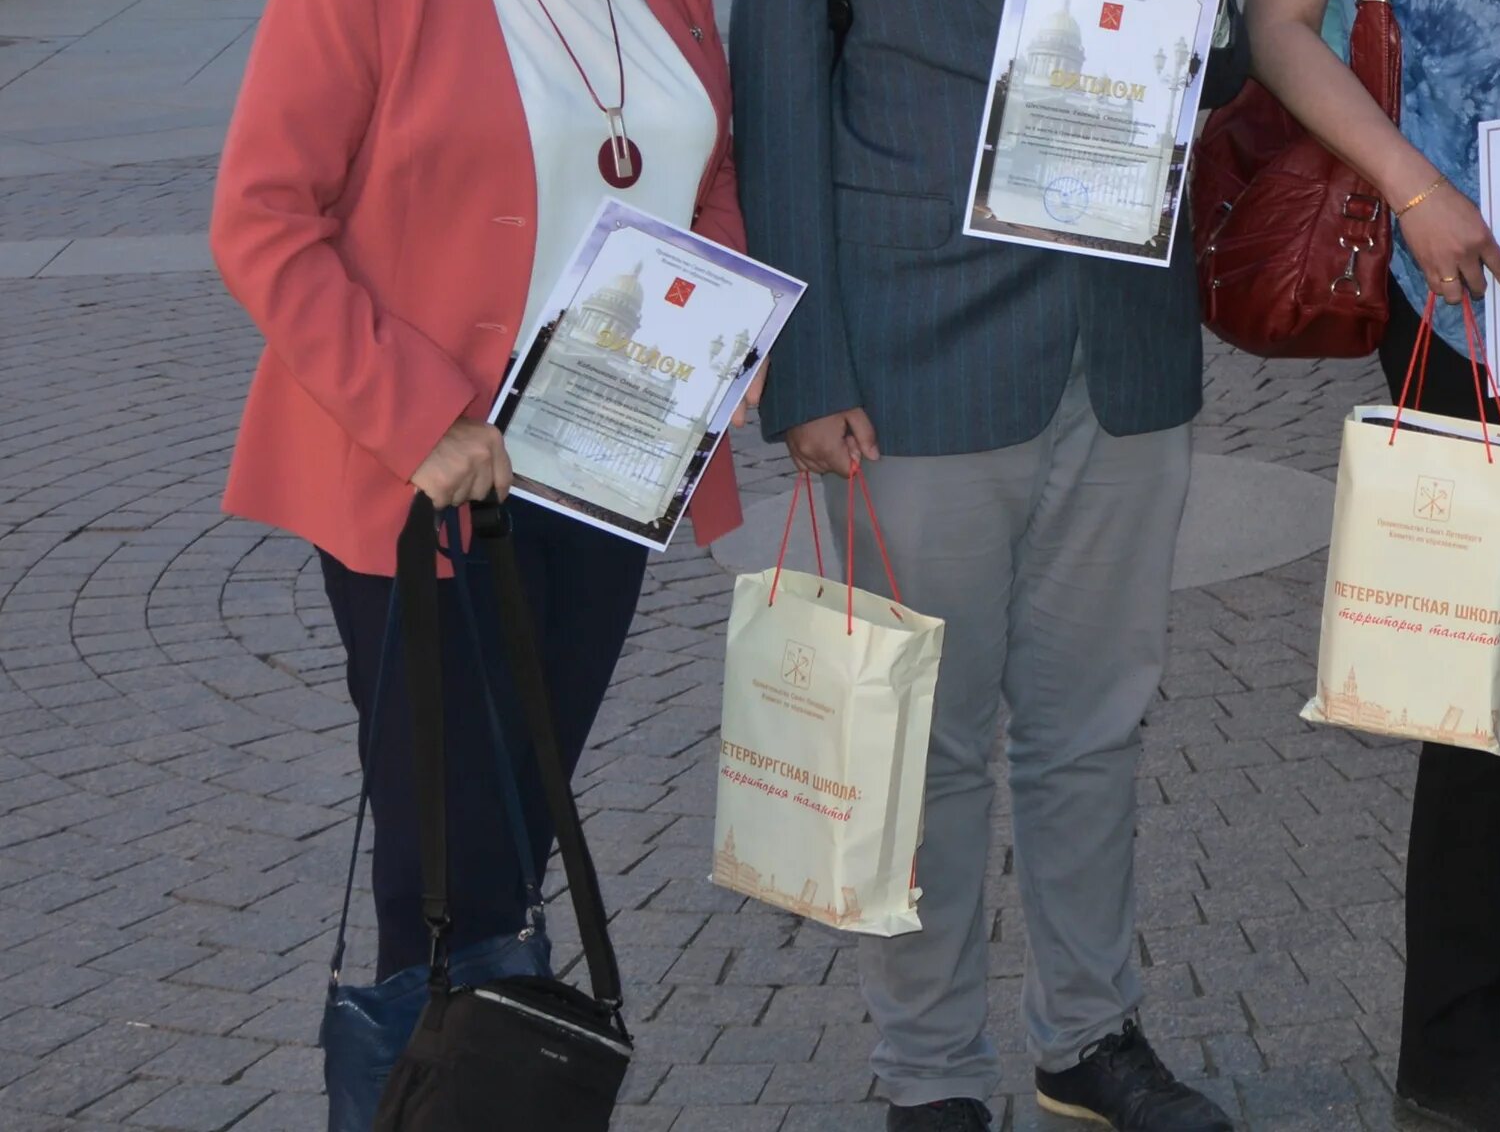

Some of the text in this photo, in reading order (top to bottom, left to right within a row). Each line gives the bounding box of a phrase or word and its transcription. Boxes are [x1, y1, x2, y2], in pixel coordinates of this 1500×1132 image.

[1334, 580, 1450, 616] ПЕТЕРБУРГСКАЯ
[1338, 607, 1423, 633] территория
[721, 766, 853, 822] территория талантов
[812, 773, 862, 801] ШКОЛА:
